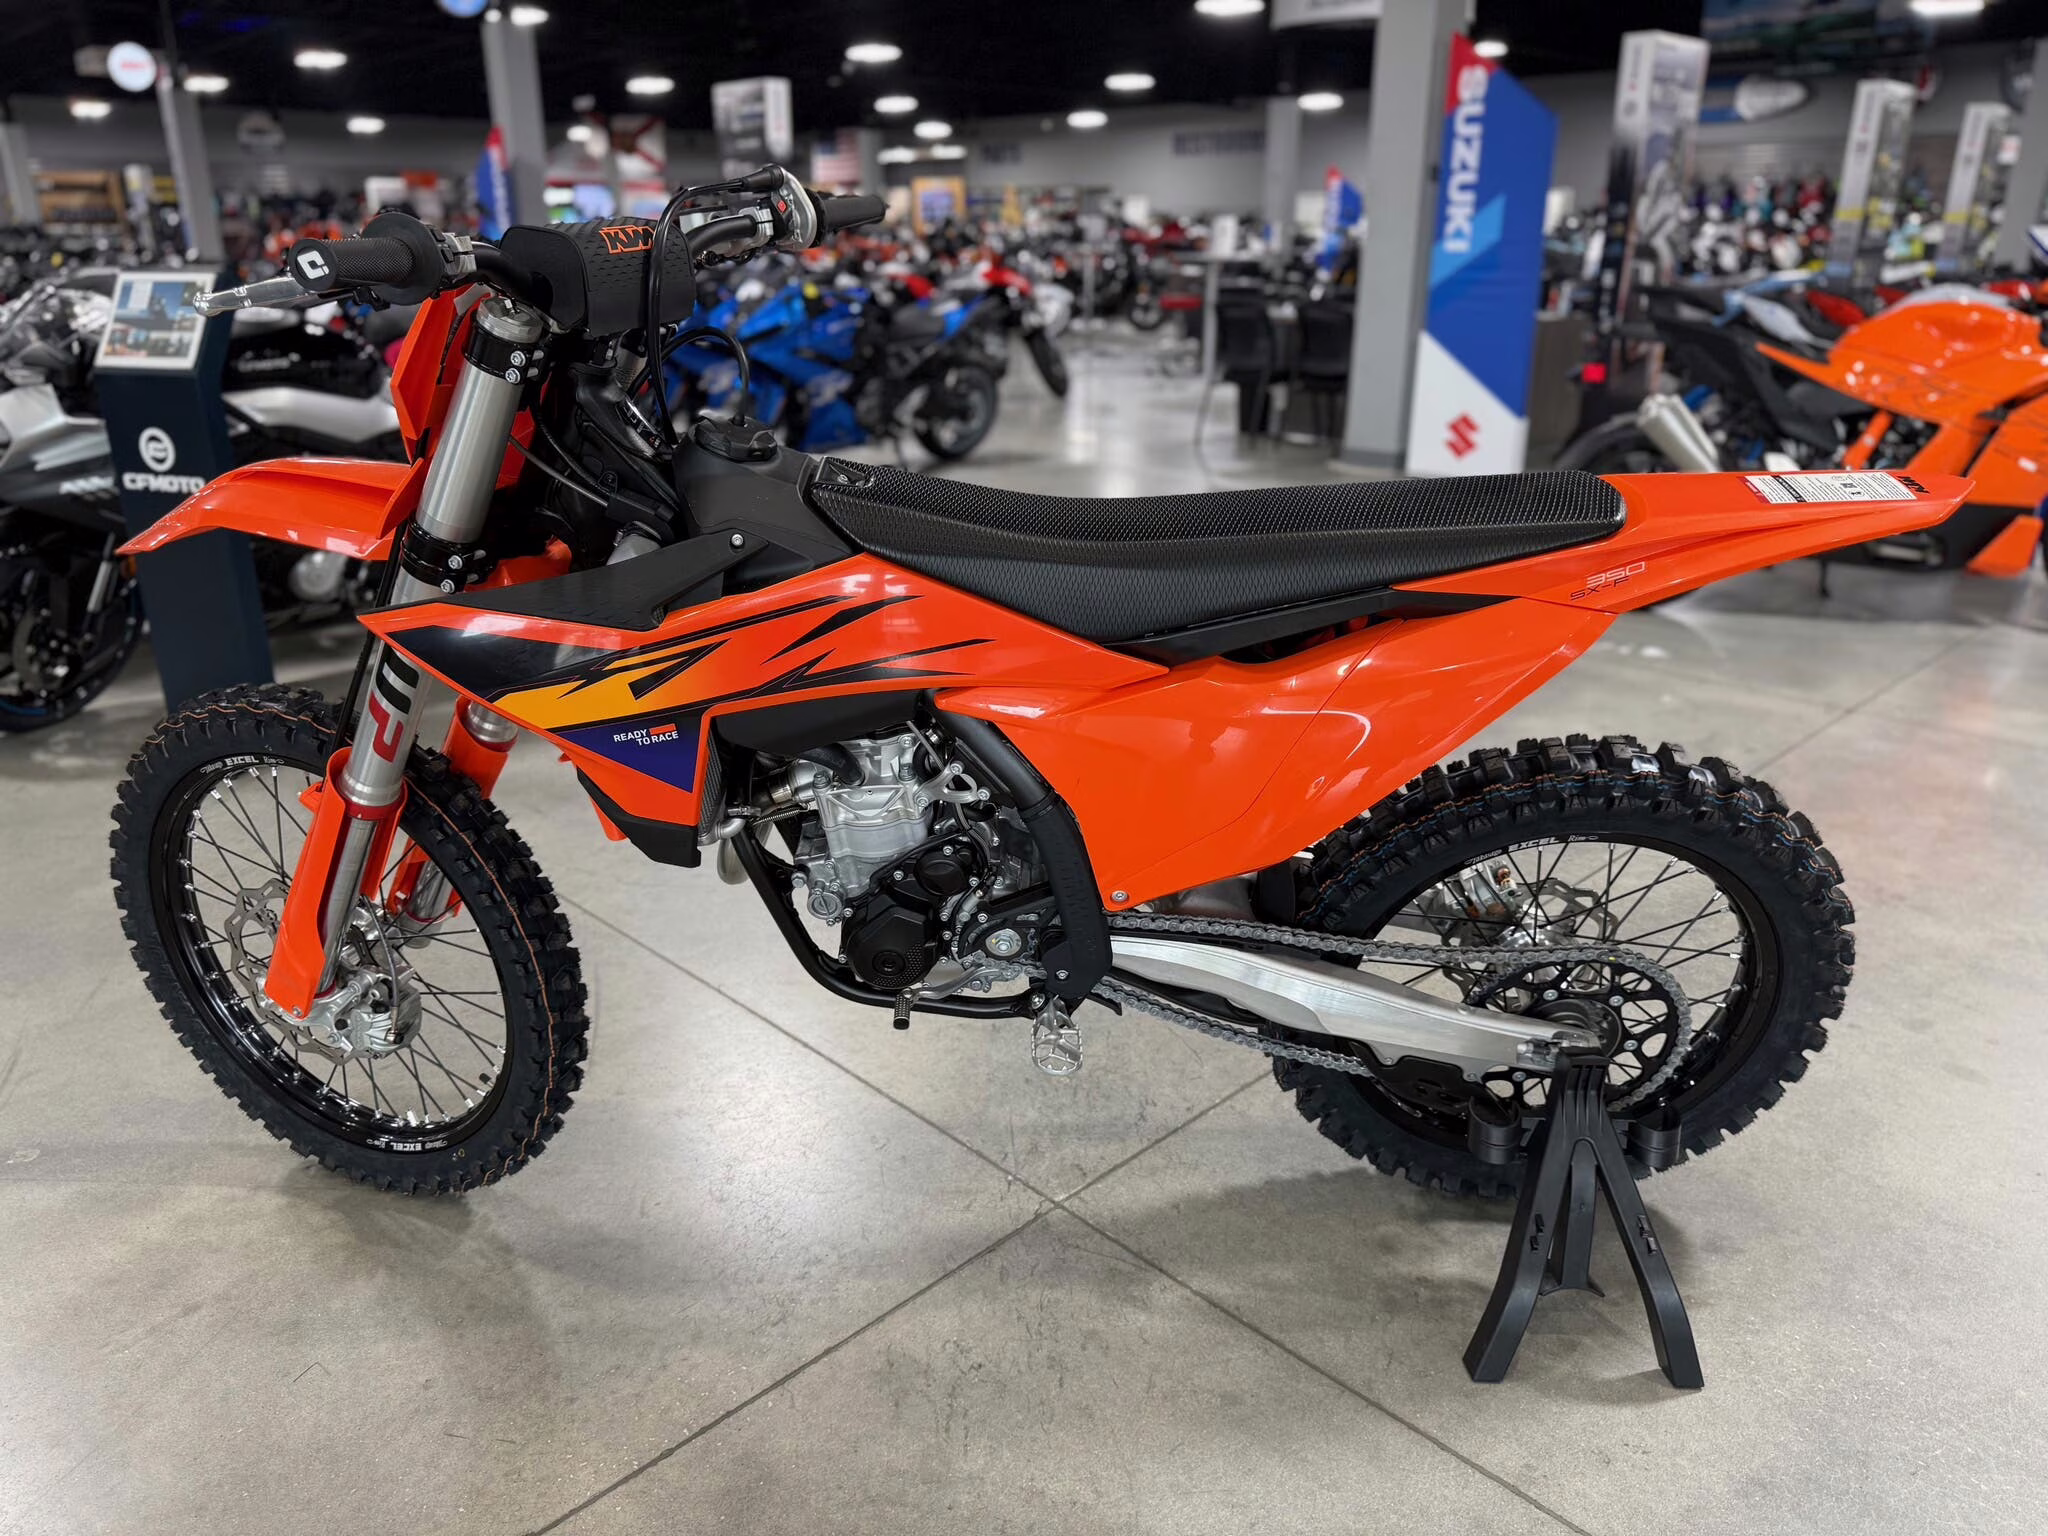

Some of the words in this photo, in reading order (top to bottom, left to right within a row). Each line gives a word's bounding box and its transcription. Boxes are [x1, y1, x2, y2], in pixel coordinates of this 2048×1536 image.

[1443, 64, 1488, 253] SUZUKI
[599, 224, 656, 254] KTM
[122, 471, 205, 495] CFMOTO
[1586, 561, 1646, 588] 350
[1570, 575, 1630, 601] SX-F
[613, 728, 648, 743] READY
[635, 736, 651, 746] TO
[650, 730, 679, 744] RACE
[224, 755, 260, 766] EXCEL
[1507, 836, 1560, 852] EXCEL
[390, 1142, 422, 1152] EXCEL
